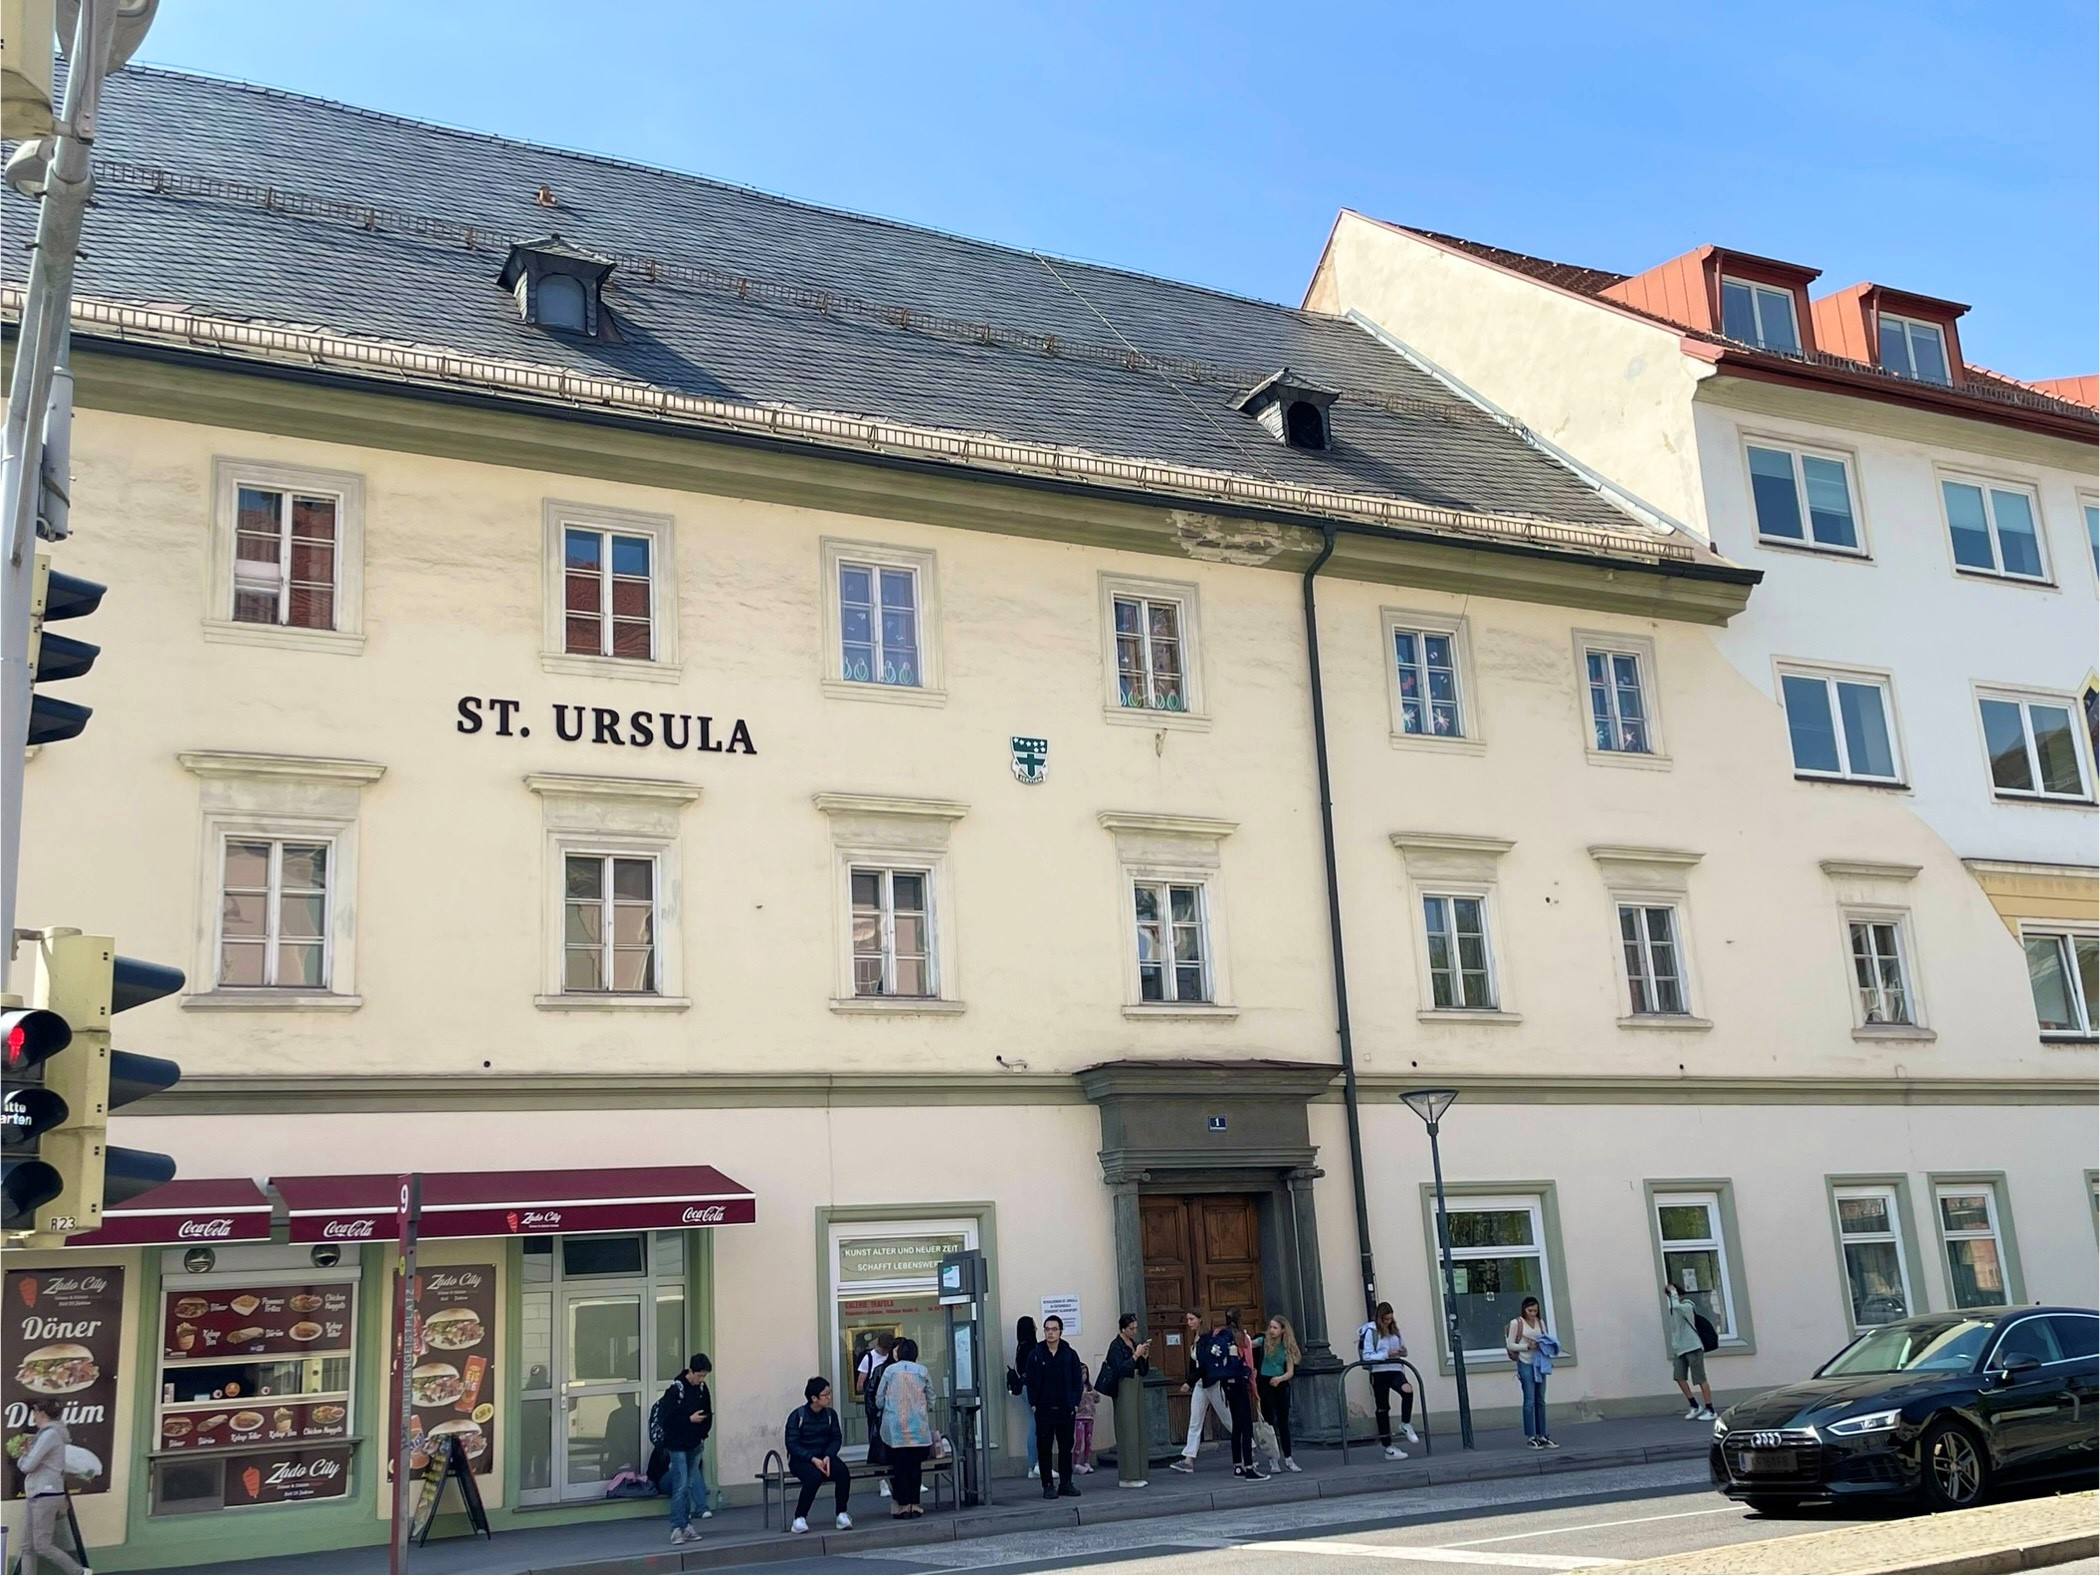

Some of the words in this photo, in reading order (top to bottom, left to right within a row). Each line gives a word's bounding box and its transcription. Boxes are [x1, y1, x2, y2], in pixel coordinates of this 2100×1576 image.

[457, 696, 530, 738] ST.
[552, 704, 758, 755] URSULA
[4, 1102, 27, 1113] itte
[0, 1112, 32, 1125] arten
[1215, 1117, 1220, 1127] 1
[400, 1184, 409, 1214] 9
[520, 1212, 544, 1224] Zado
[544, 1211, 562, 1223] City
[682, 1205, 727, 1223] Coca-Cola
[51, 1217, 76, 1231] R23
[178, 1219, 234, 1238] Coca-Cola
[323, 1219, 376, 1238] Coca-Cola
[845, 1248, 871, 1257] KUNST
[872, 1247, 896, 1255] ALTER
[897, 1246, 915, 1254] UND
[916, 1245, 941, 1254] NEUER
[942, 1244, 959, 1253] ZEIT
[857, 1262, 892, 1271] SCHAFFT
[42, 1277, 79, 1294] Zado
[81, 1276, 108, 1293] City
[426, 1274, 457, 1290] Zado
[459, 1272, 482, 1288] City
[21, 1316, 102, 1341] Döner
[4, 1400, 105, 1428] Düm
[265, 1461, 307, 1484] Zado
[309, 1458, 341, 1479] City
